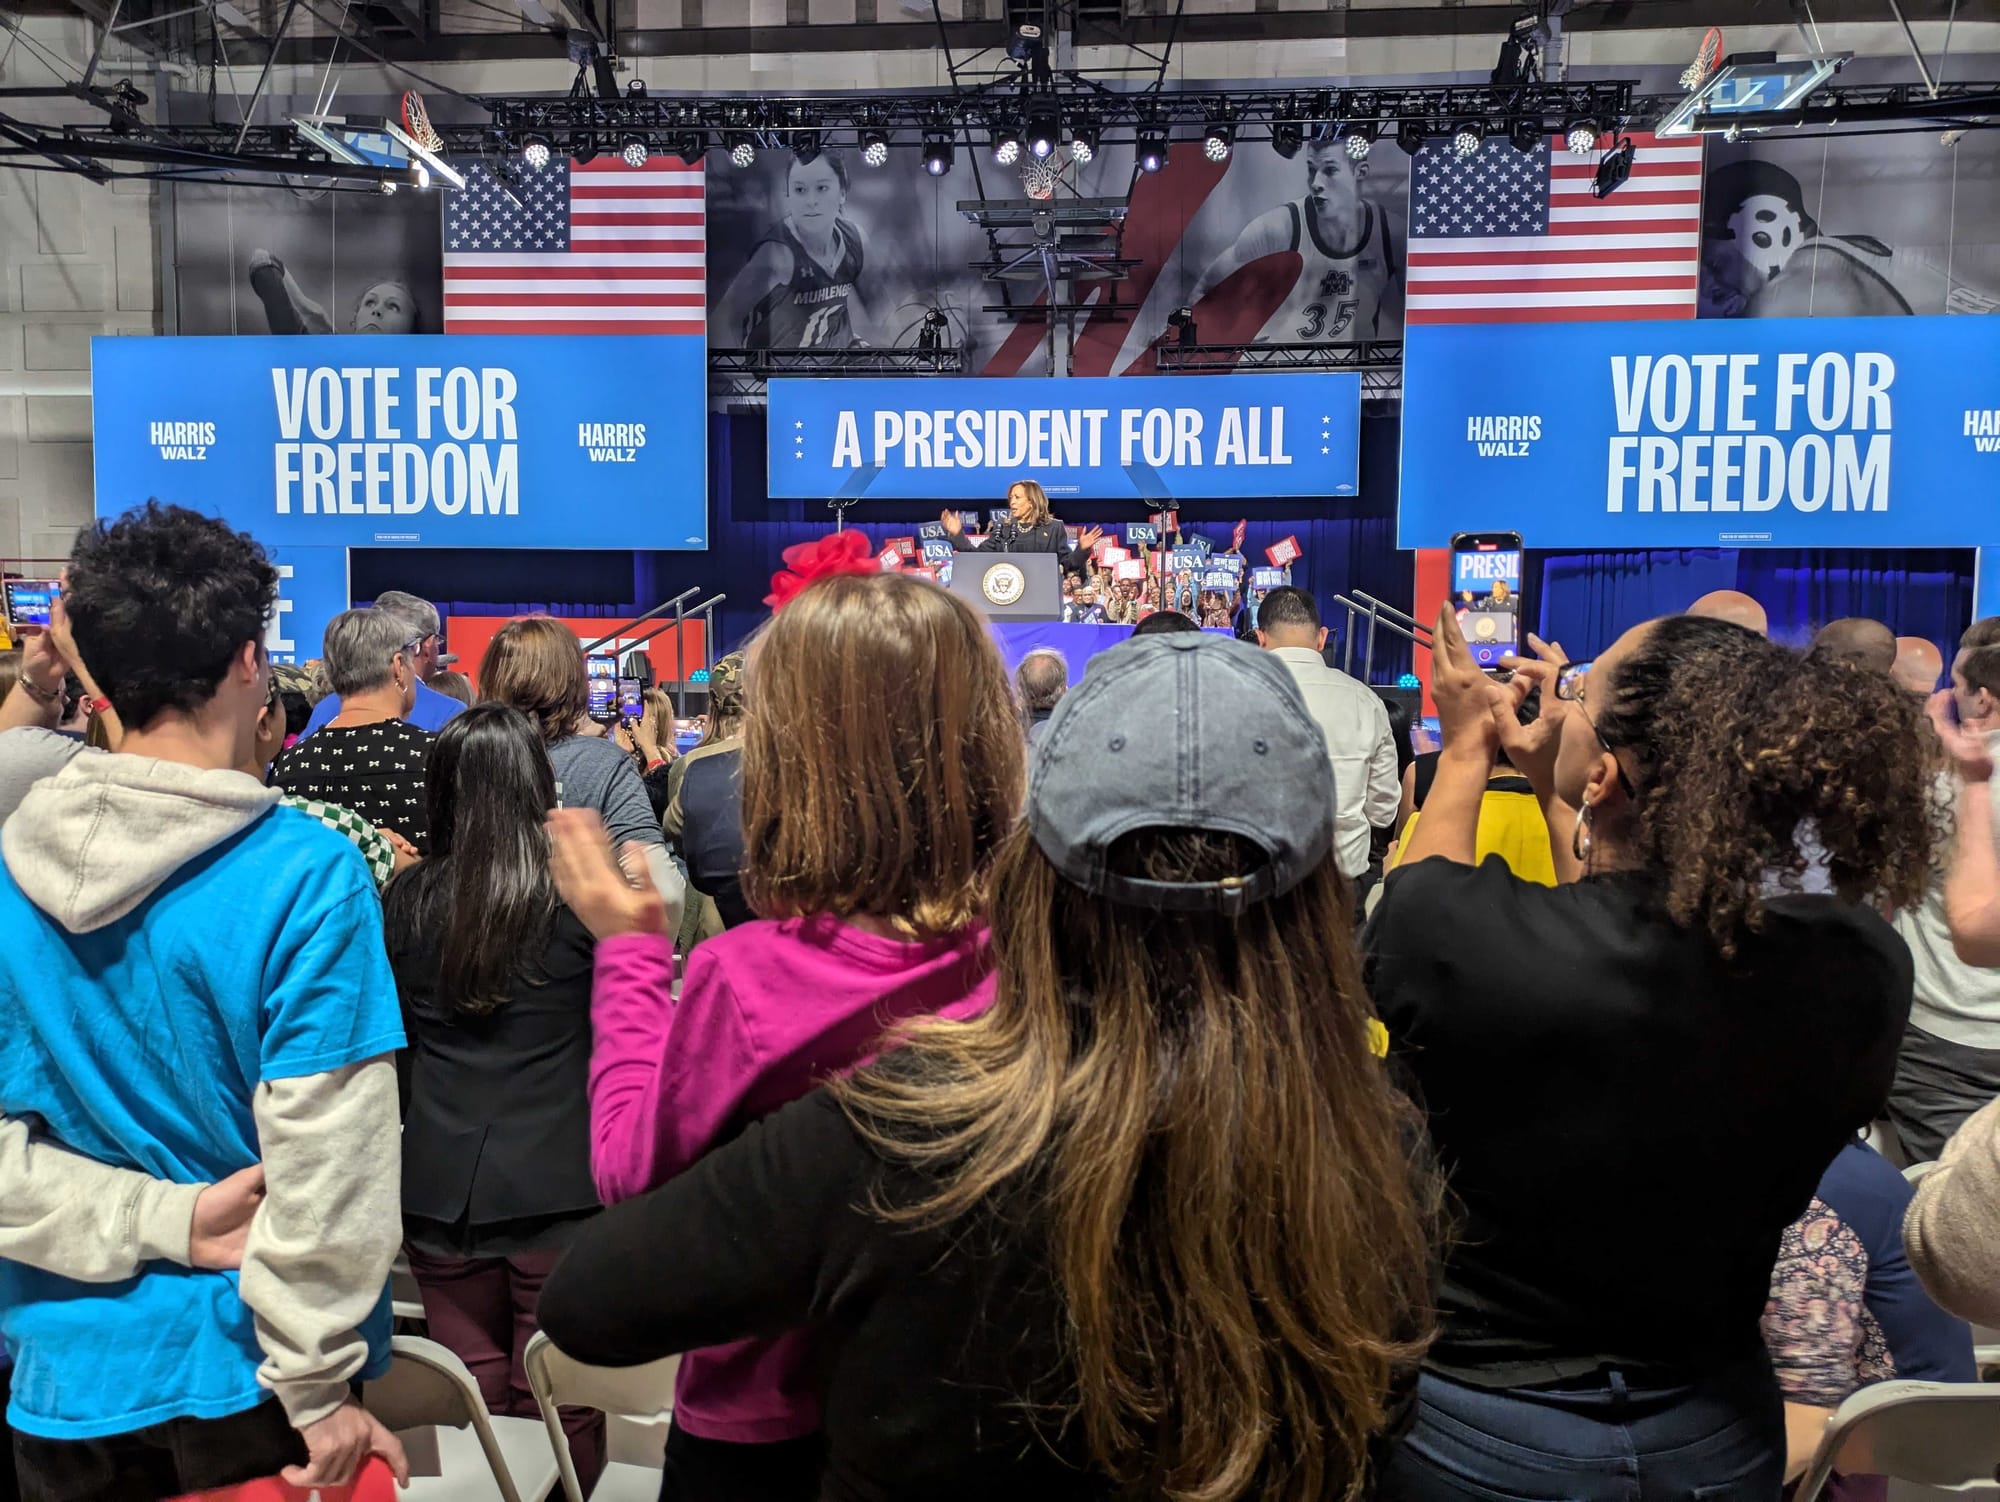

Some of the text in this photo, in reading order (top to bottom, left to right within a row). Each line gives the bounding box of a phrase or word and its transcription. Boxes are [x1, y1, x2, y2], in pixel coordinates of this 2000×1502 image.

[1296, 298, 1360, 340] 35
[272, 367, 518, 441] VOTE FOR
[1611, 352, 1896, 432] VOTE FOR
[151, 421, 216, 446] HARRIS
[579, 423, 646, 447] HARRIS
[832, 406, 1293, 469] A PRESIDENT FOR ALL
[1467, 415, 1542, 441] HARRIS
[161, 446, 207, 460] WALZ
[589, 447, 636, 462] WALZ
[1478, 442, 1530, 457] WALZ
[275, 442, 519, 516] FREEDOM
[1607, 434, 1892, 513] FREEDOM
[920, 524, 946, 538] USA
[1128, 527, 1155, 540] USA
[926, 544, 952, 558] USA
[1174, 555, 1204, 569] USA
